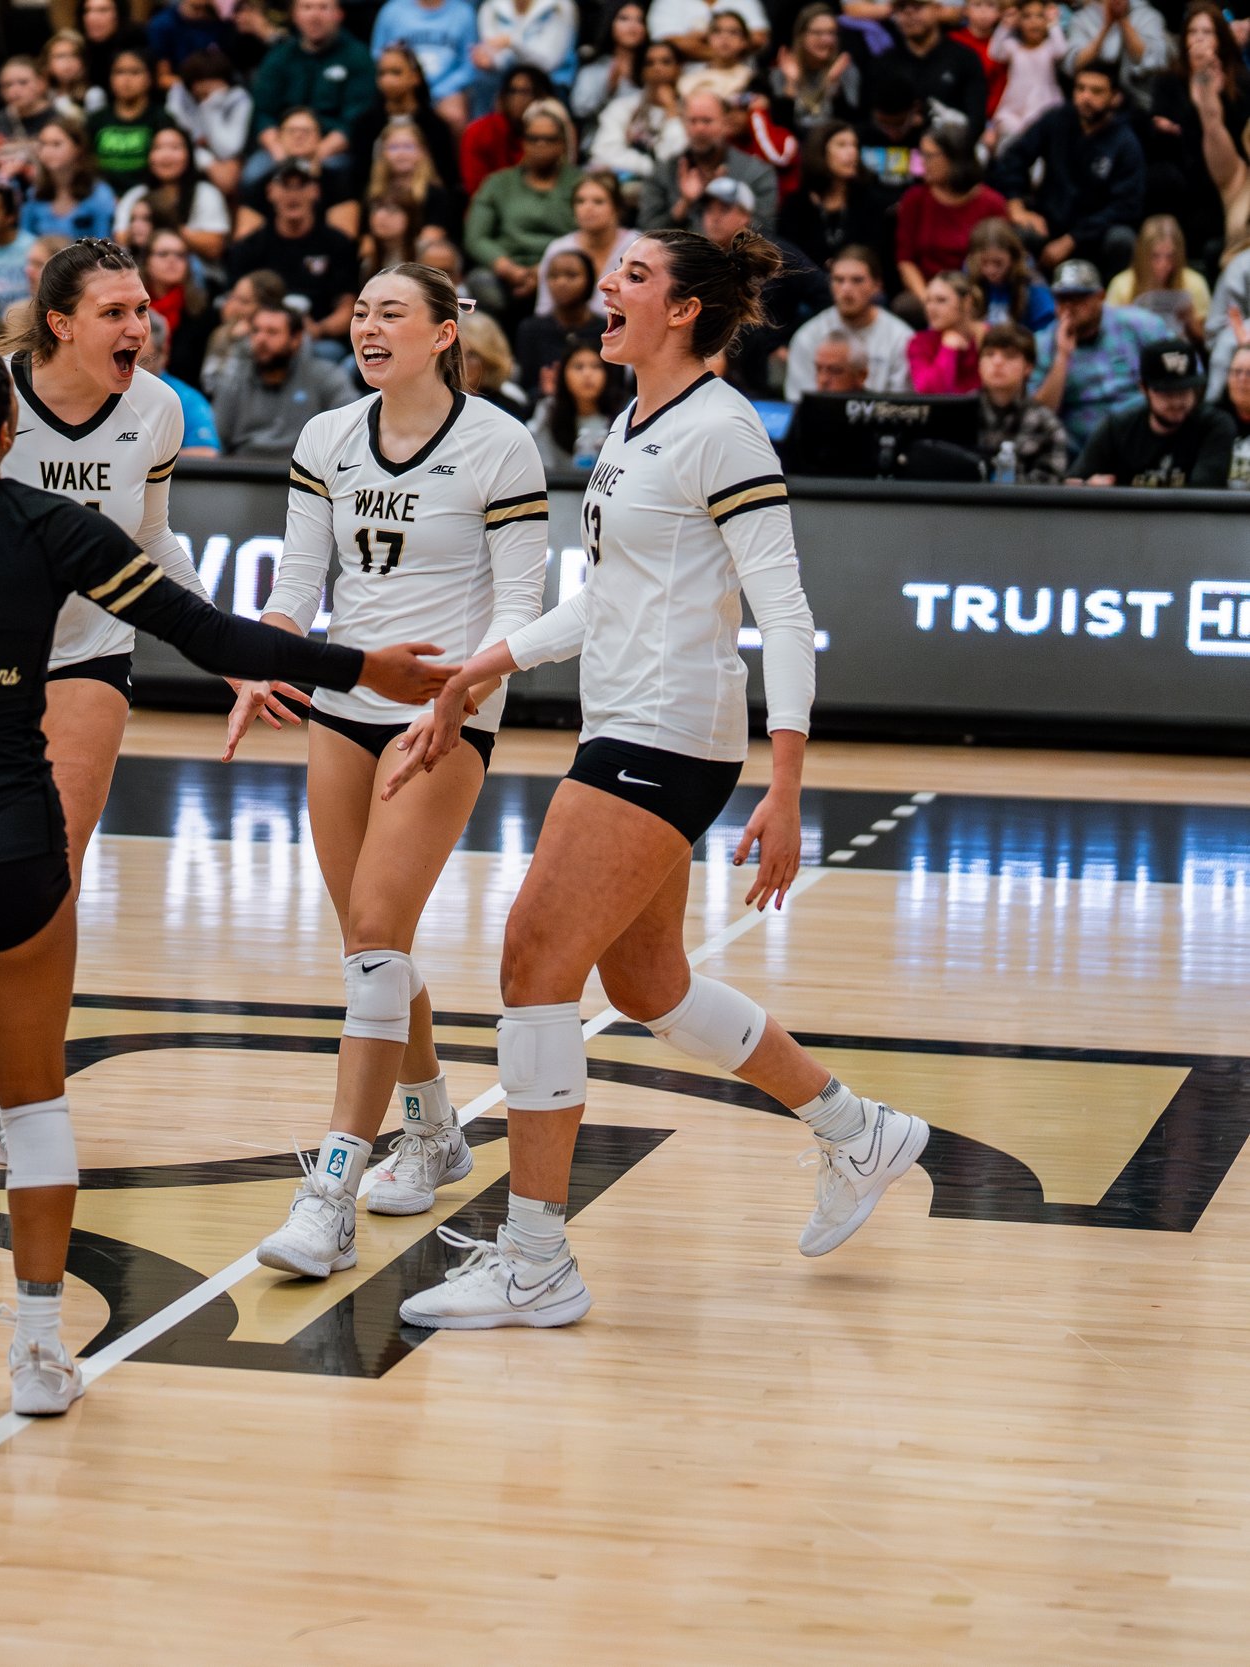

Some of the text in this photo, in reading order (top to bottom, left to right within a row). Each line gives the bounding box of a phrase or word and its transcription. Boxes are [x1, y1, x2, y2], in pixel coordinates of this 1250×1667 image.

[116, 432, 139, 441] ACC
[642, 443, 662, 455] ACC
[40, 461, 111, 491] WAKE
[429, 464, 457, 475] ACC
[589, 461, 625, 497] WAKE
[354, 489, 420, 522] WAKE
[354, 526, 405, 575] 17
[902, 582, 1175, 639] TRUIST
